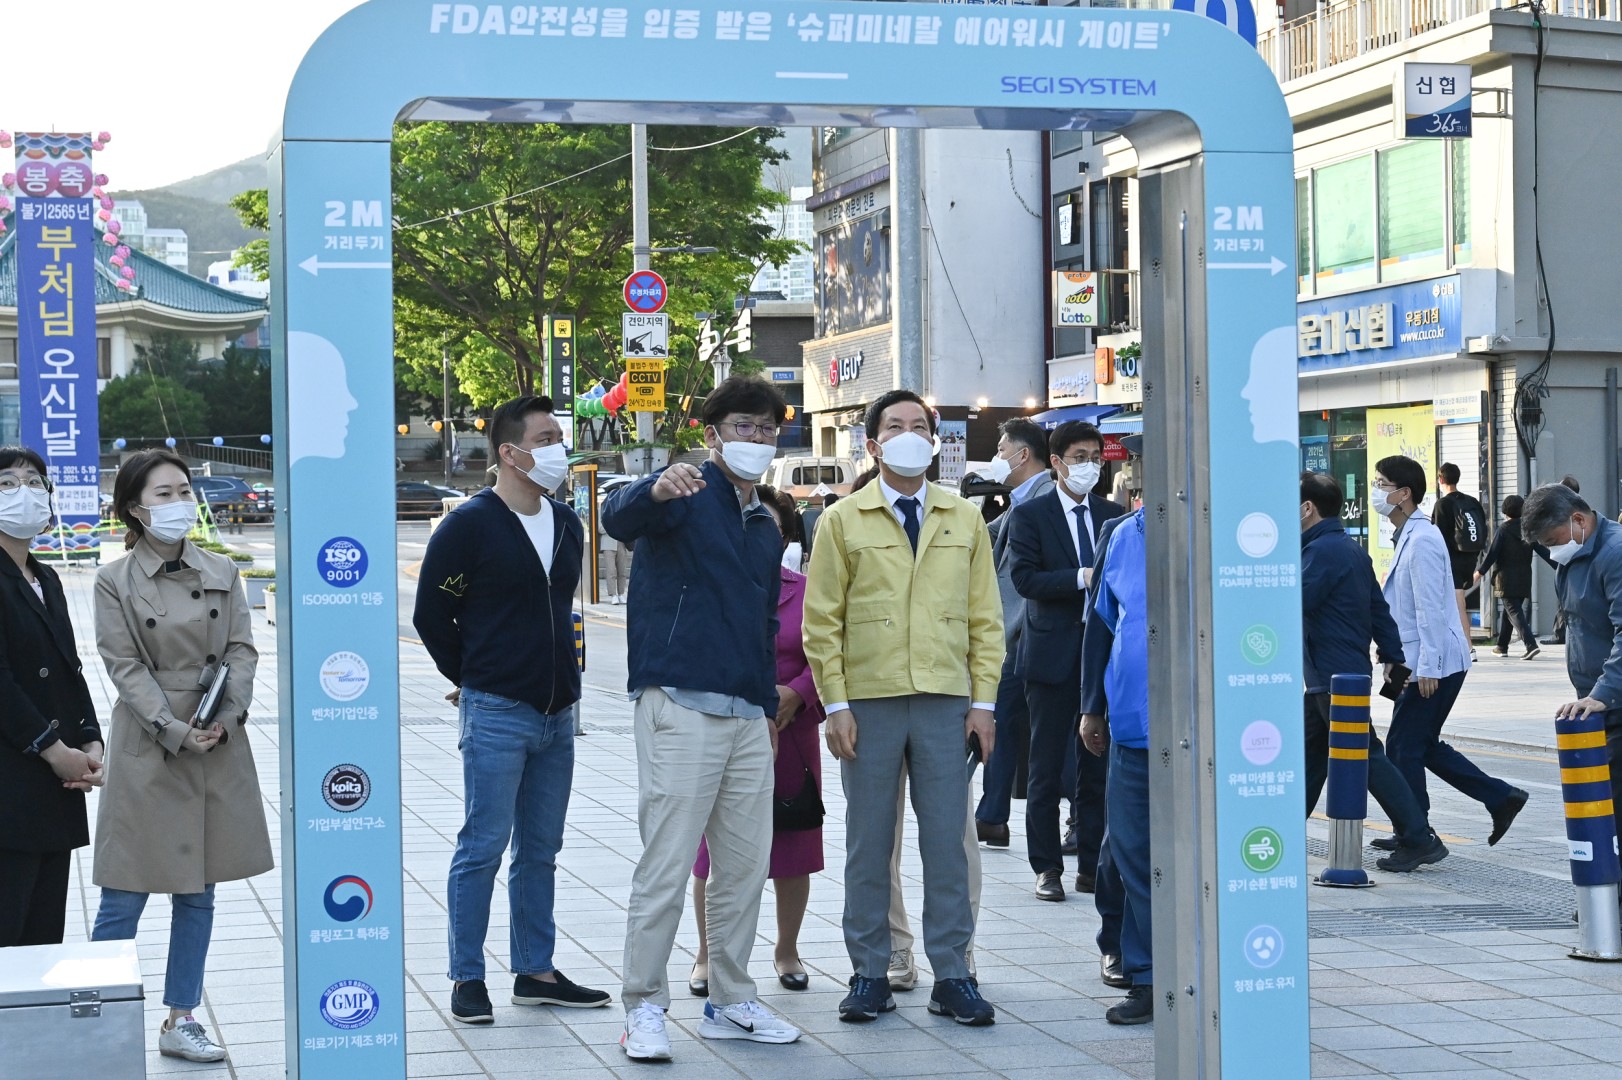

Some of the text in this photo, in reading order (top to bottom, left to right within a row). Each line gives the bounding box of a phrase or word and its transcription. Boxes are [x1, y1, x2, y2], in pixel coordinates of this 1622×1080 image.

[430, 4, 627, 38] FDA안전성을
[643, 9, 701, 39] 입증
[716, 11, 772, 41] 받은
[954, 18, 1065, 48] 에어워시
[1416, 77, 1455, 95] 신협
[1426, 113, 1460, 133] 365
[324, 236, 384, 250] 거리두기
[1213, 238, 1265, 252] 거리두기
[37, 225, 77, 337] 부처님
[630, 289, 662, 297] 주정차금지
[628, 317, 645, 327] 견인
[1061, 313, 1092, 323] Lotto
[1400, 326, 1446, 343] www.cu.co.kr
[561, 342, 570, 357] 3
[631, 373, 659, 382] CCTV
[40, 348, 80, 457] 오신날
[1464, 512, 1478, 542] adidas
[325, 548, 361, 563] ISO
[326, 570, 360, 581] 9001
[1254, 564, 1279, 576] 안전성
[1280, 563, 1296, 575] 인증
[1254, 576, 1279, 588] 안전성
[1280, 575, 1297, 587] 인증
[303, 592, 384, 606] ISO90001 인증
[1228, 673, 1292, 687] 항균력 99.99%
[311, 706, 380, 721] 벤처기업인증
[1276, 771, 1295, 783] 살균
[331, 781, 361, 794] koita
[1238, 784, 1286, 798] 테스트 완료
[307, 816, 387, 832] 기업부설연구소
[1228, 876, 1298, 892] 공기 순환 필터링
[309, 926, 391, 943] 쿨링포그 특허증
[1234, 976, 1296, 993] 청정 습도 유지
[332, 993, 368, 1010] GMP
[304, 1032, 399, 1051] 의료기기 제조 허가
